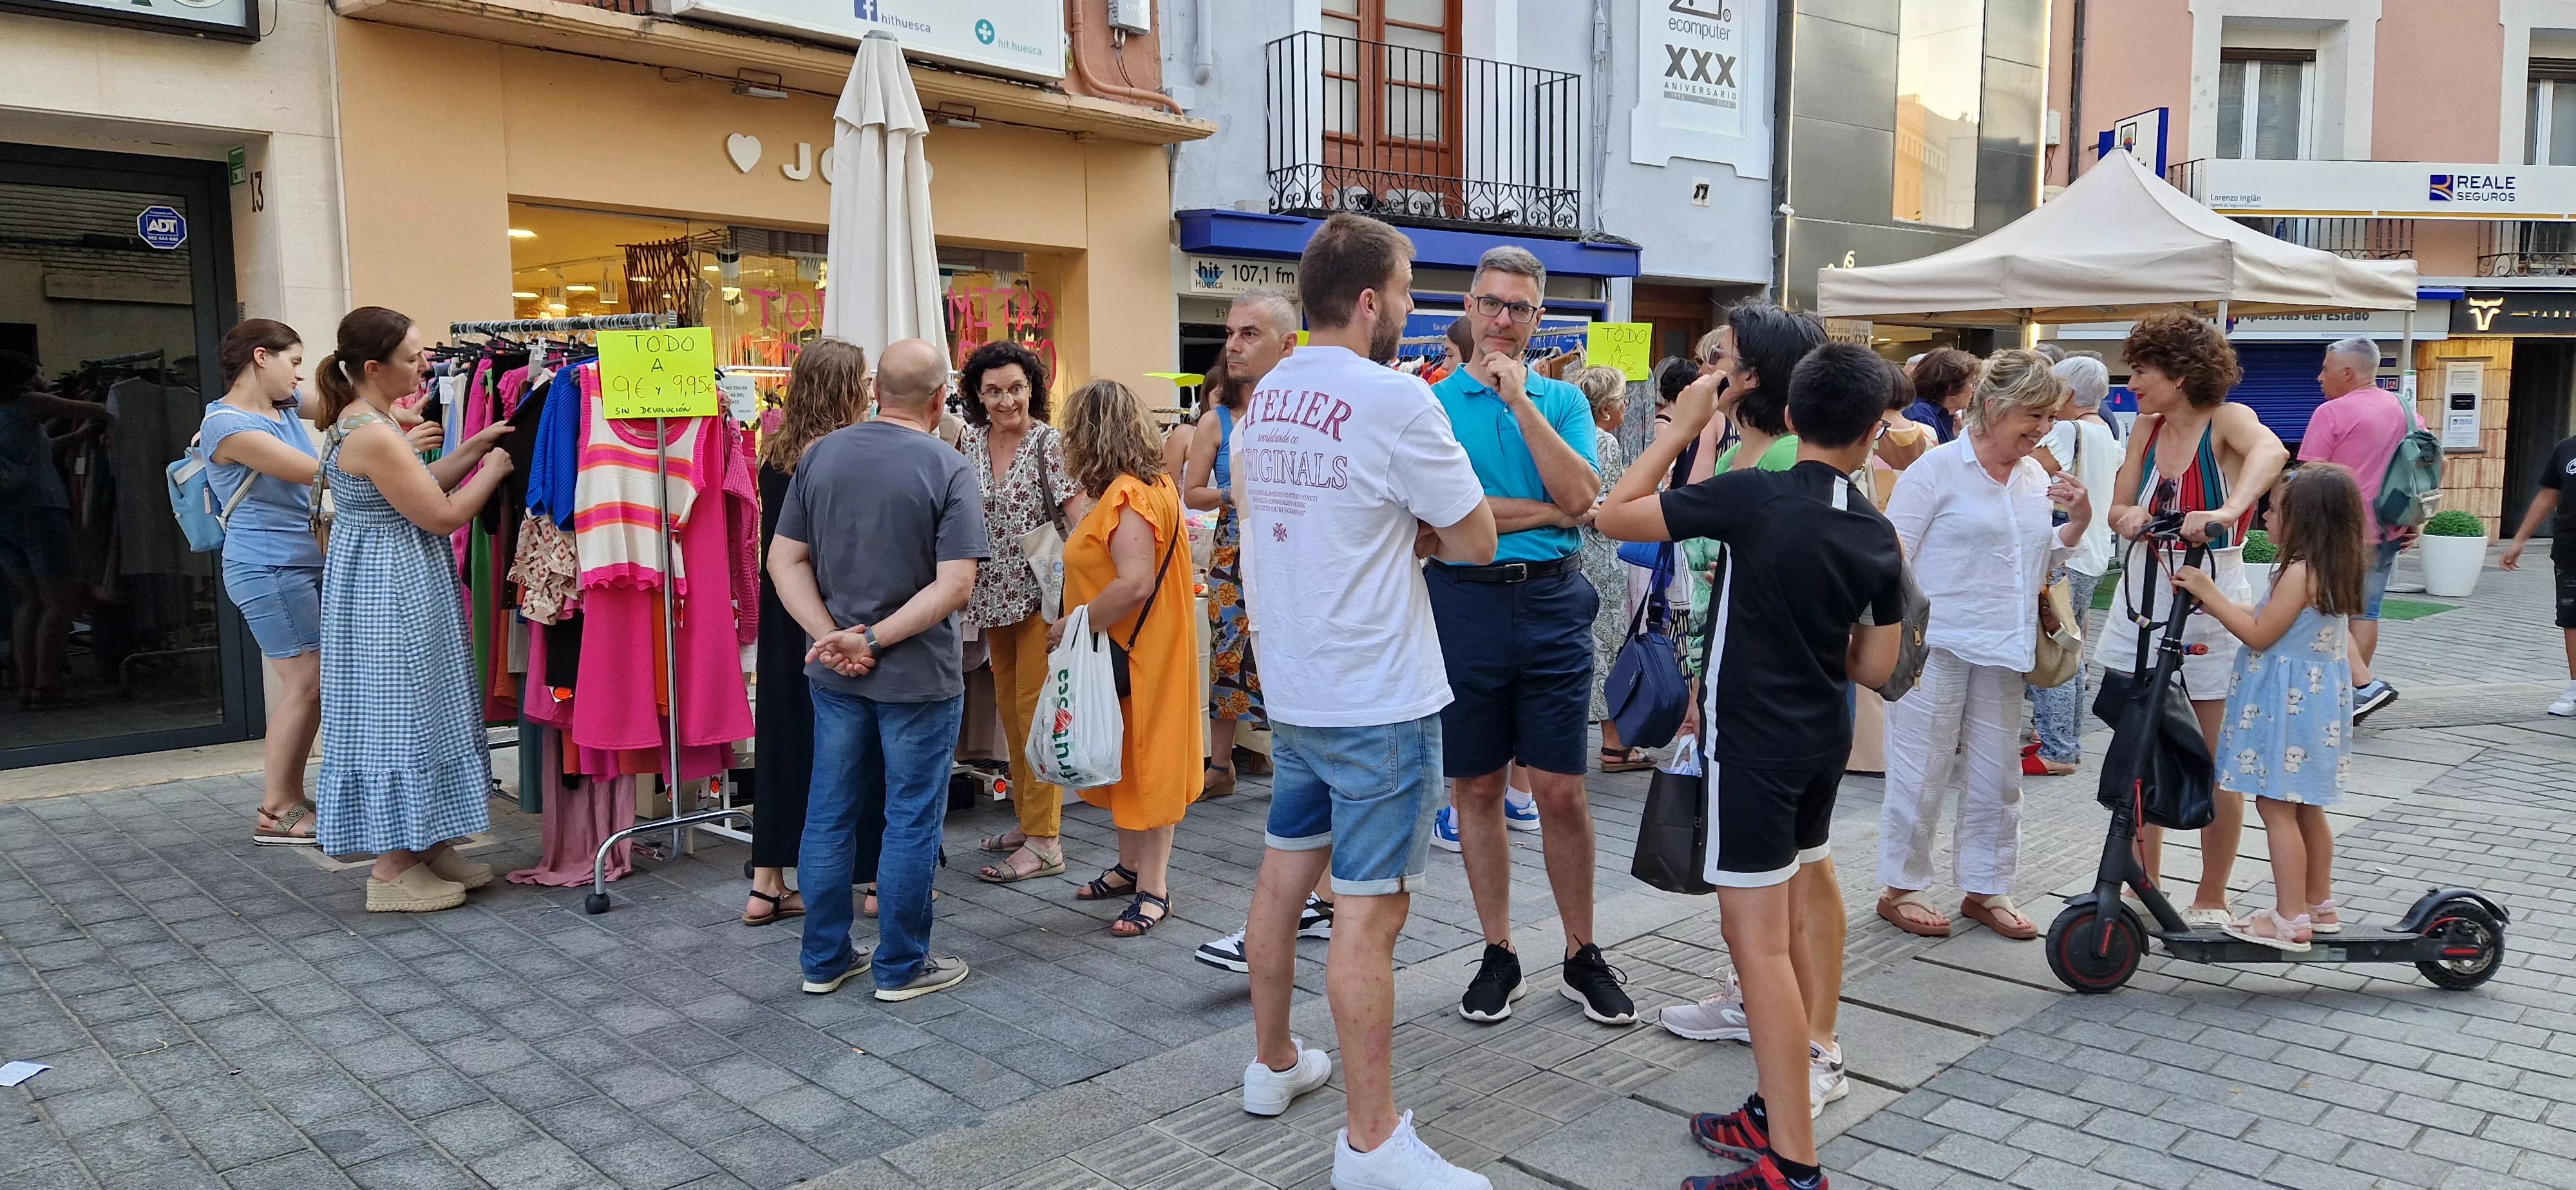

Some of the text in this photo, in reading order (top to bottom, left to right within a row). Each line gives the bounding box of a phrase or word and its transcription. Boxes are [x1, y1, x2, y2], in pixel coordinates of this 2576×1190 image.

[881, 13, 931, 33] hithuesca
[1669, 17, 1730, 41] ecomputer
[998, 38, 1042, 56] hit huesca
[1664, 43, 1737, 88] XXX
[1664, 81, 1736, 100] ANIVERSARIO
[2458, 175, 2516, 189] REALE
[250, 171, 264, 213] 13
[1694, 183, 1710, 200] 17
[2240, 194, 2261, 203] Inglán
[2457, 192, 2515, 202] SEGUROS
[147, 218, 177, 233] ADT
[1198, 261, 1220, 279] hit
[1232, 264, 1294, 286] 107,1 fm
[1195, 279, 1224, 289] Huesca
[948, 285, 1055, 332] MITAD
[1215, 308, 1226, 318] 15
[2532, 310, 2576, 318] TABE
[627, 334, 694, 352] TODO
[1602, 326, 1647, 344] TODO
[1615, 344, 1621, 353] A
[651, 358, 664, 372] A
[672, 375, 714, 397] 9,95€
[615, 402, 691, 415] SIN DEVOLUCIÓN
[1257, 427, 1300, 444] worldwide co.
